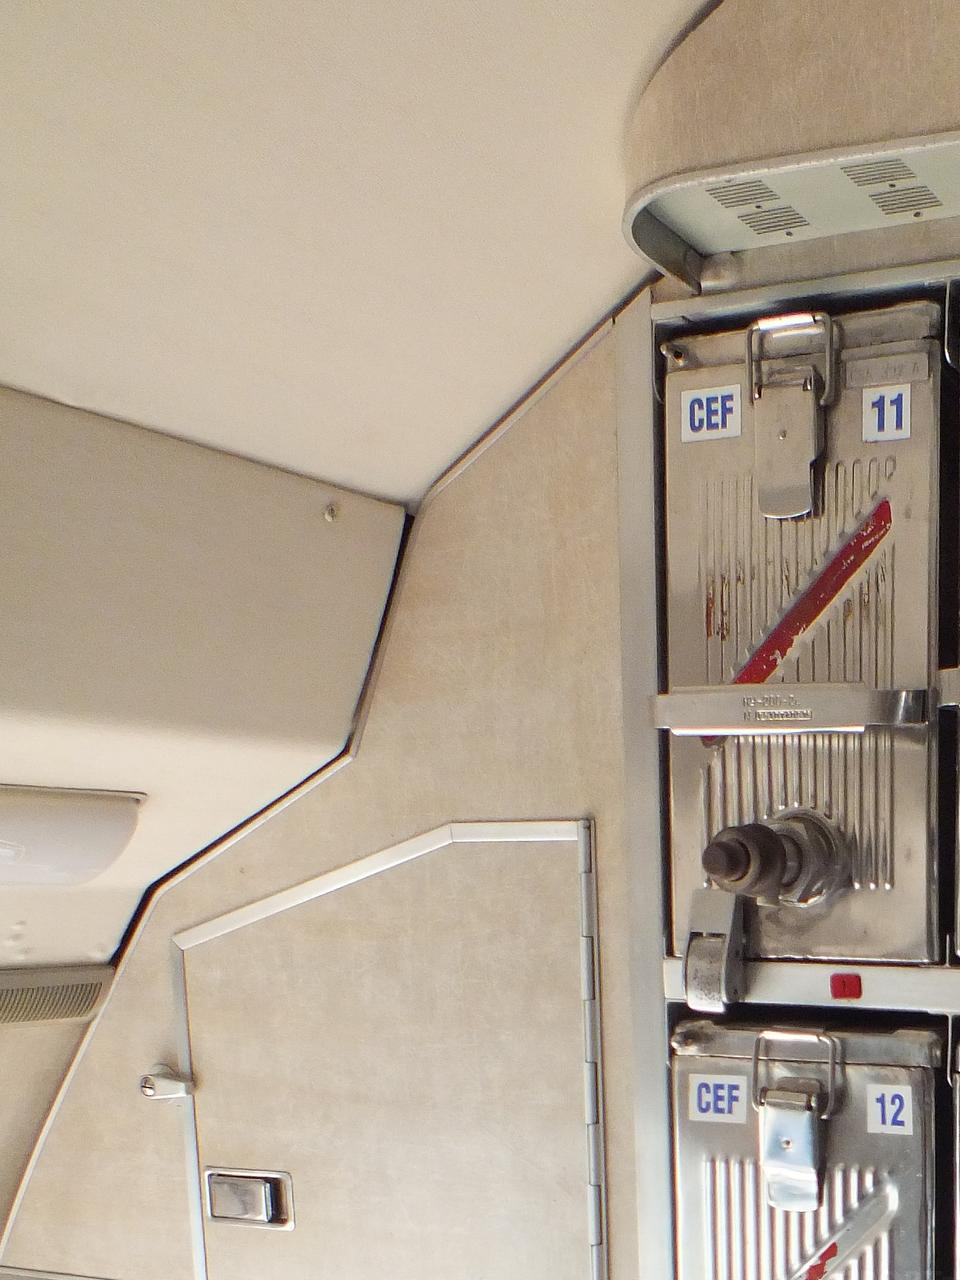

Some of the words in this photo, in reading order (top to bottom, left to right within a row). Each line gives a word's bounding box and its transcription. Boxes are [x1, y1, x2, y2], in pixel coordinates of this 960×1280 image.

[689, 395, 734, 433] CEF
[871, 394, 904, 432] 11
[696, 1082, 740, 1117] CEF
[876, 1094, 905, 1127] 12
